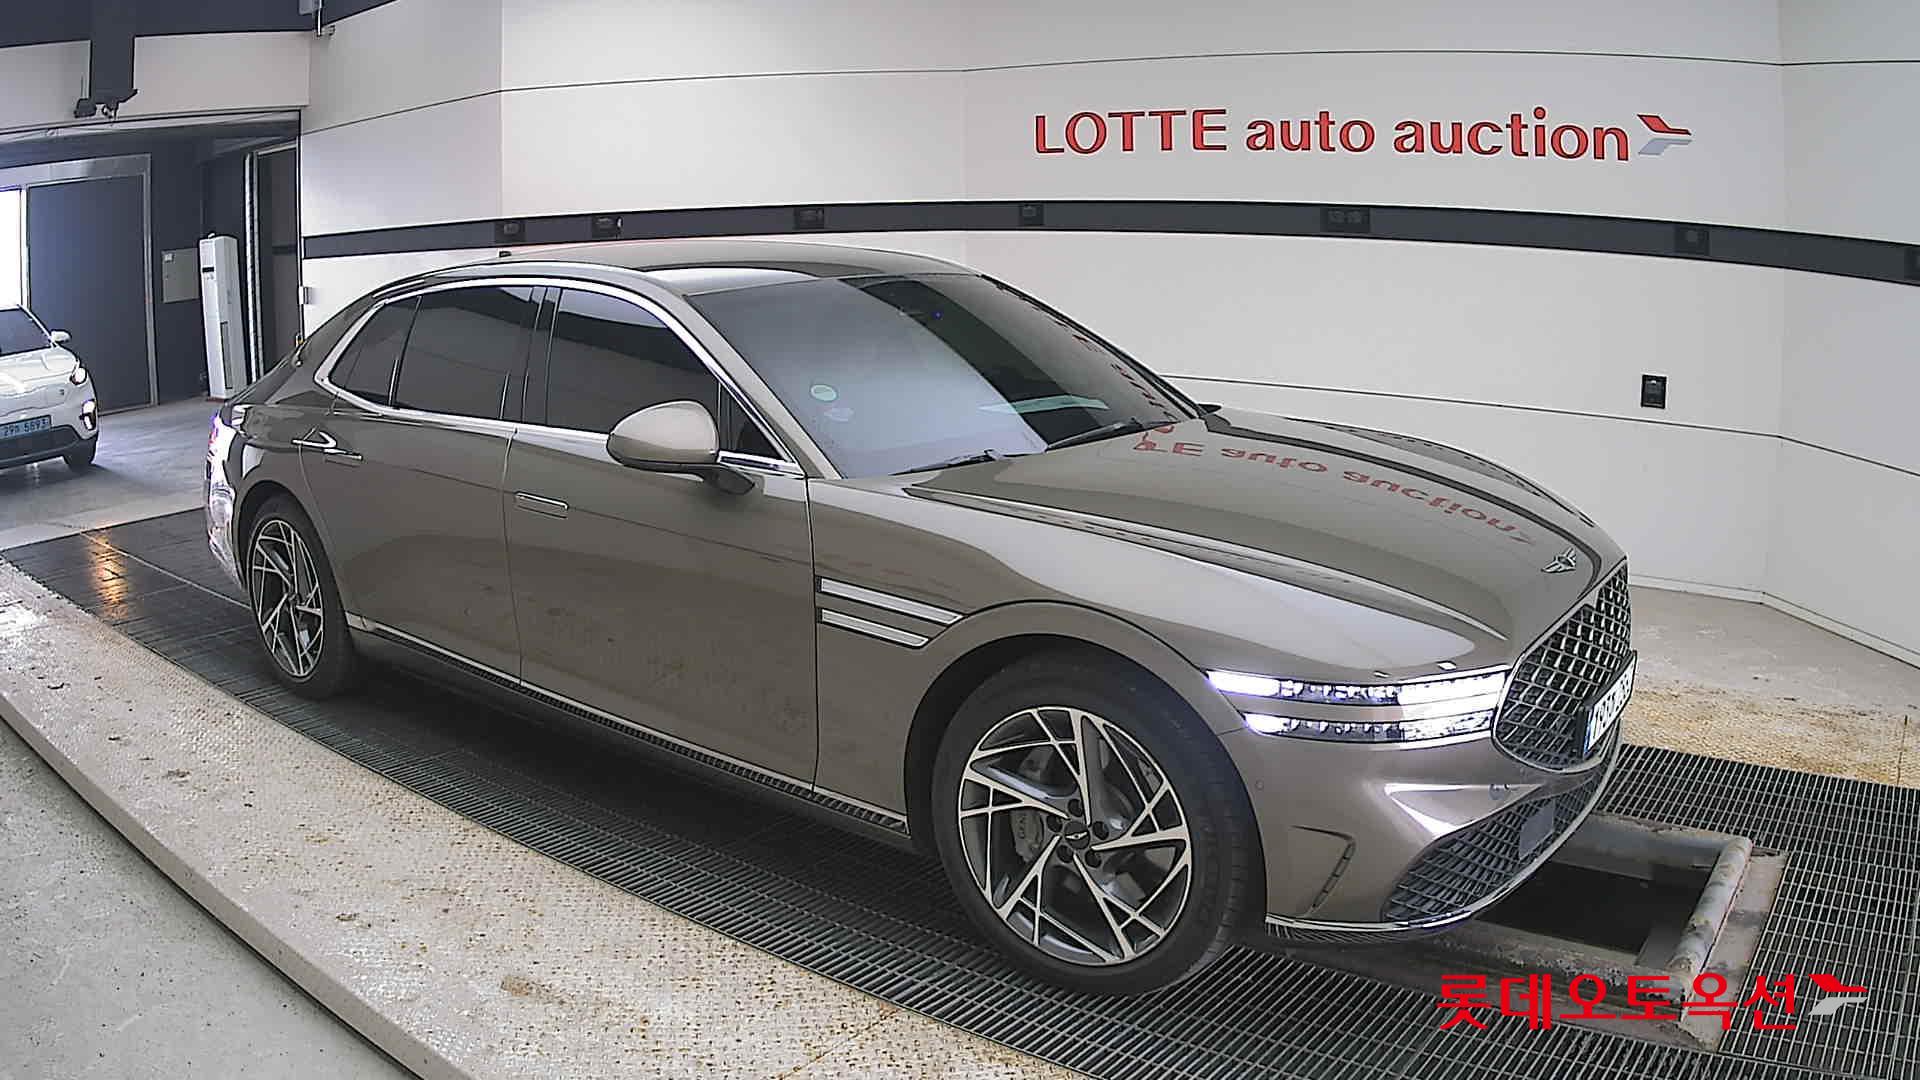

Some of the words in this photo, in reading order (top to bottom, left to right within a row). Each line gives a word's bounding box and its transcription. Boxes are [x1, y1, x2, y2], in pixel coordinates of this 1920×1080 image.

[1034, 108, 1228, 155] LOTTE
[1246, 110, 1376, 153] auto
[1393, 106, 1630, 161] auction
